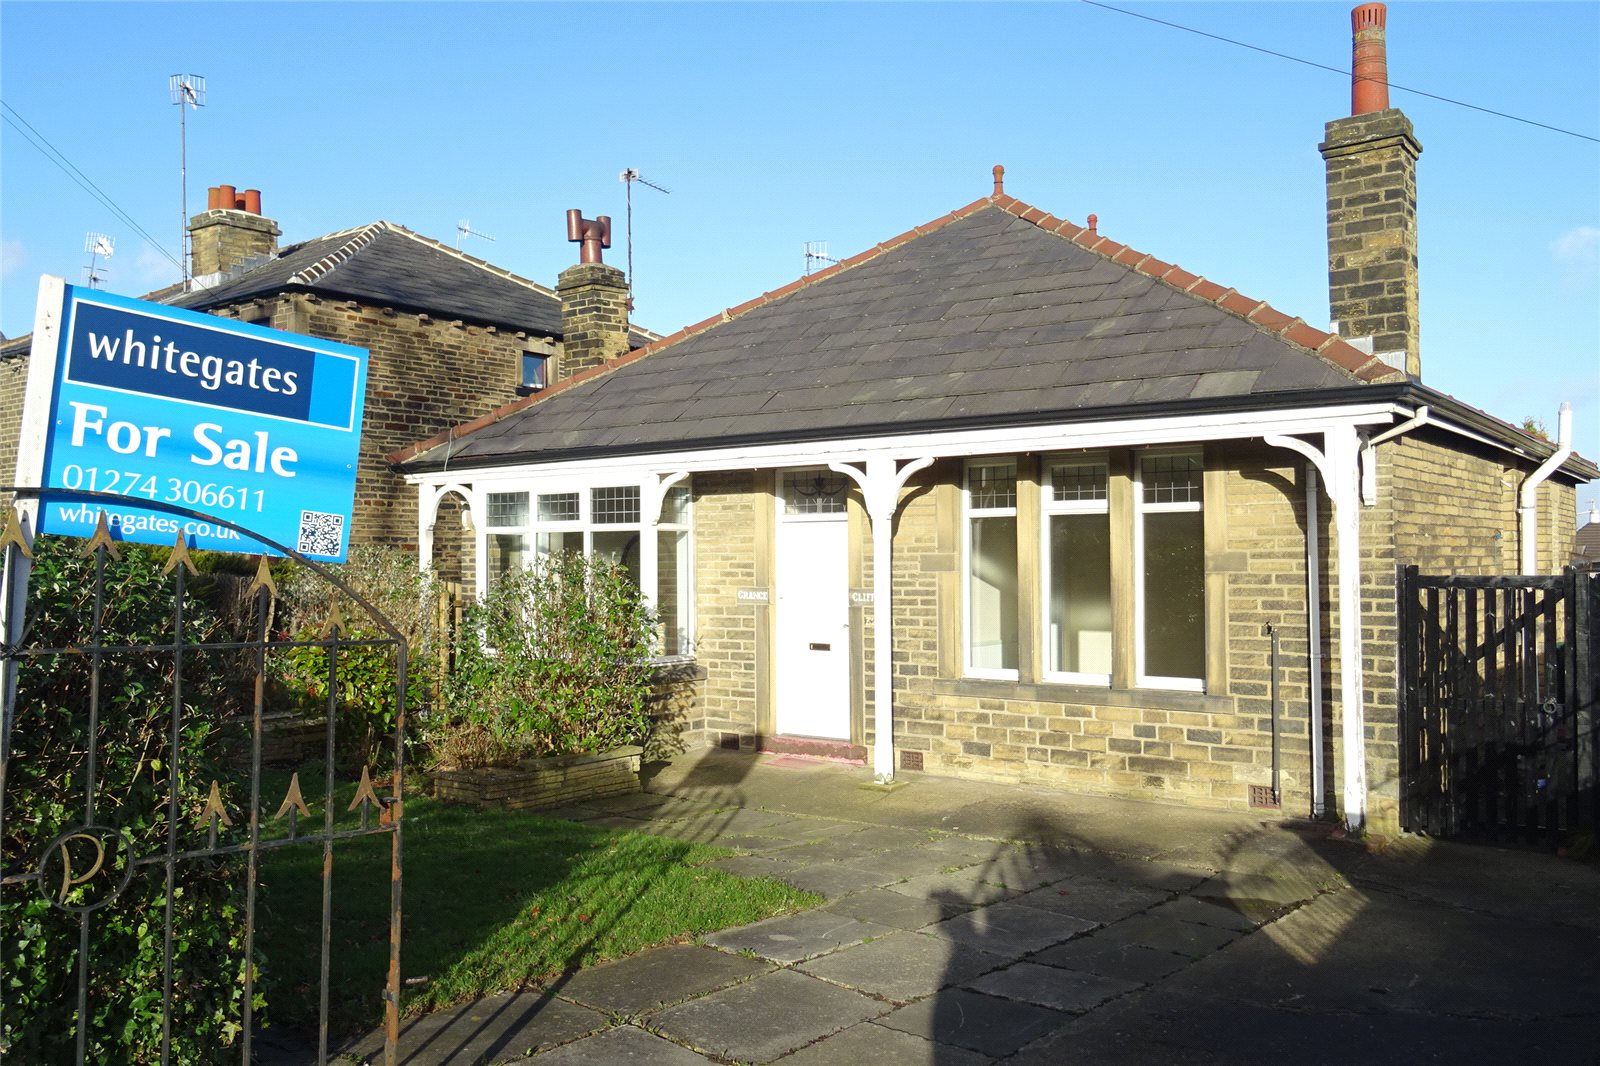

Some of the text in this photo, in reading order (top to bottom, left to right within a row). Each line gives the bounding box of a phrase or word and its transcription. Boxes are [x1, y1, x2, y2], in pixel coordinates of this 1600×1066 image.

[88, 329, 298, 396] whitegates
[69, 401, 298, 478] For Sale
[62, 464, 265, 512] 01274 306611
[59, 503, 240, 540] whiegatesco.uk
